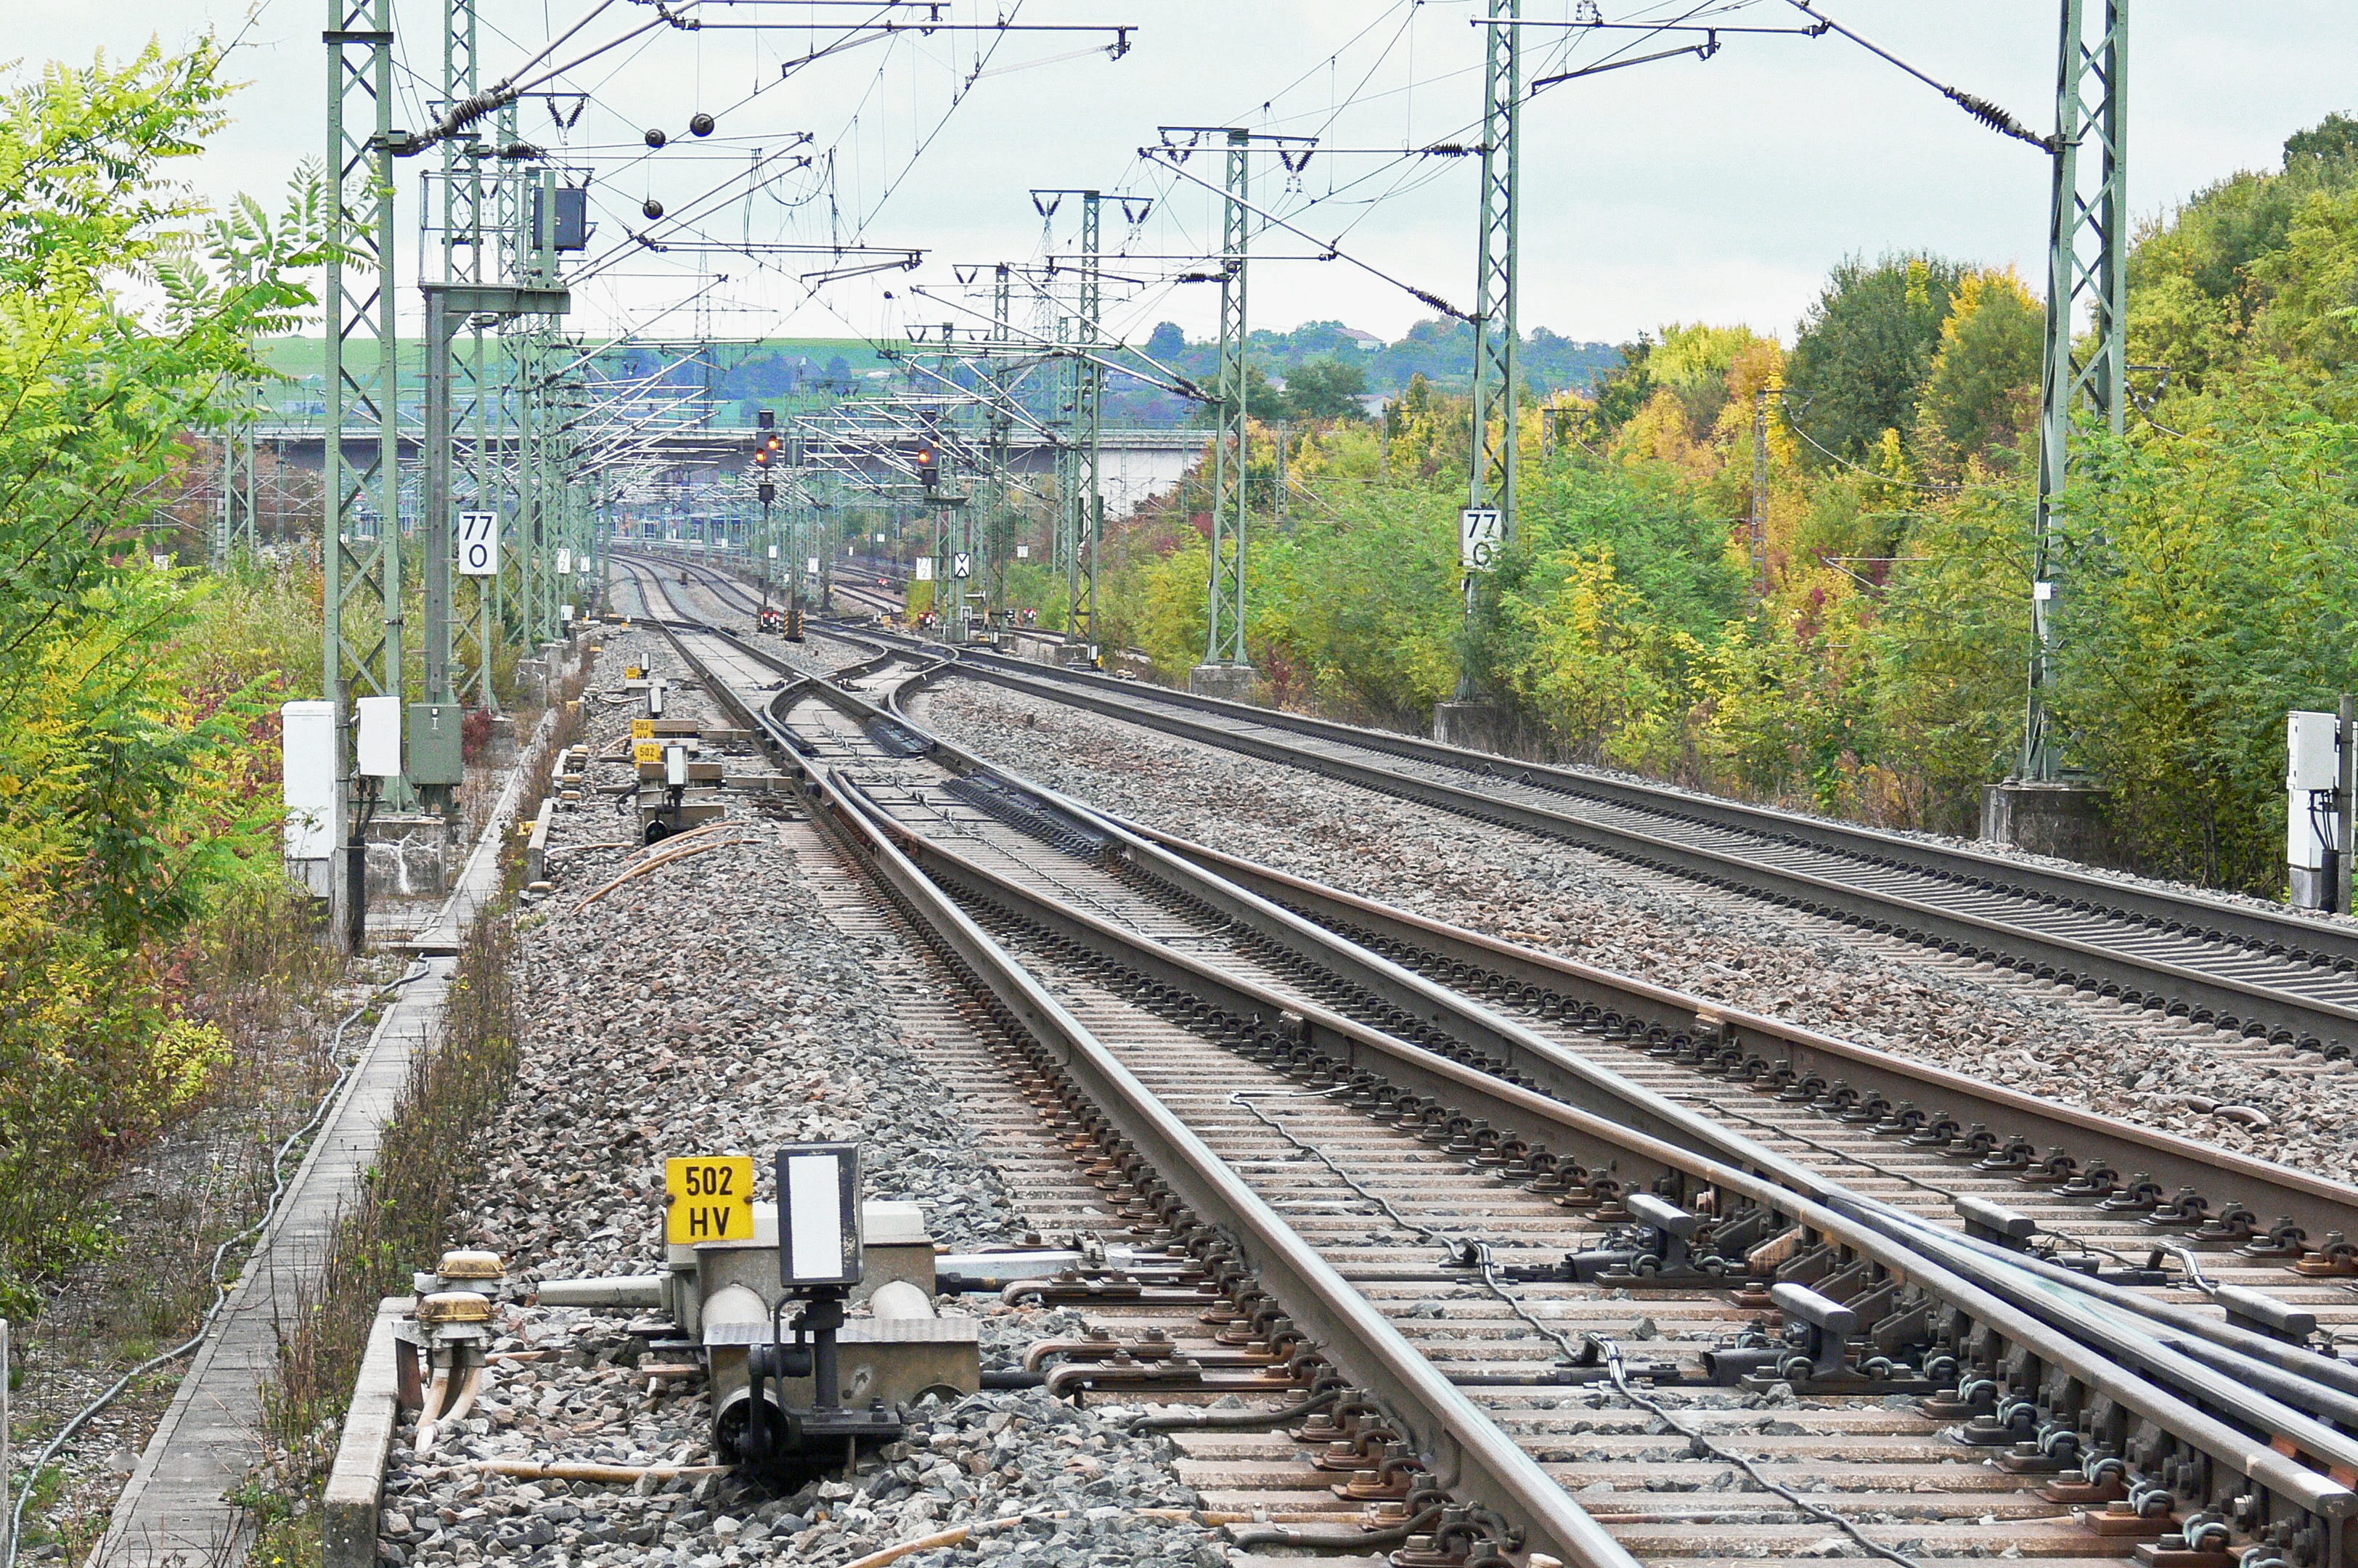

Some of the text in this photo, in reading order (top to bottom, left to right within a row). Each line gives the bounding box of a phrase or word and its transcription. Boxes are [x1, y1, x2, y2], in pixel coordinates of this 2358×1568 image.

[463, 515, 493, 541] 77
[1467, 513, 1498, 539] 77
[468, 544, 488, 568] 0
[640, 747, 655, 756] 502
[686, 1166, 733, 1196] 502
[690, 1206, 730, 1236] HV
